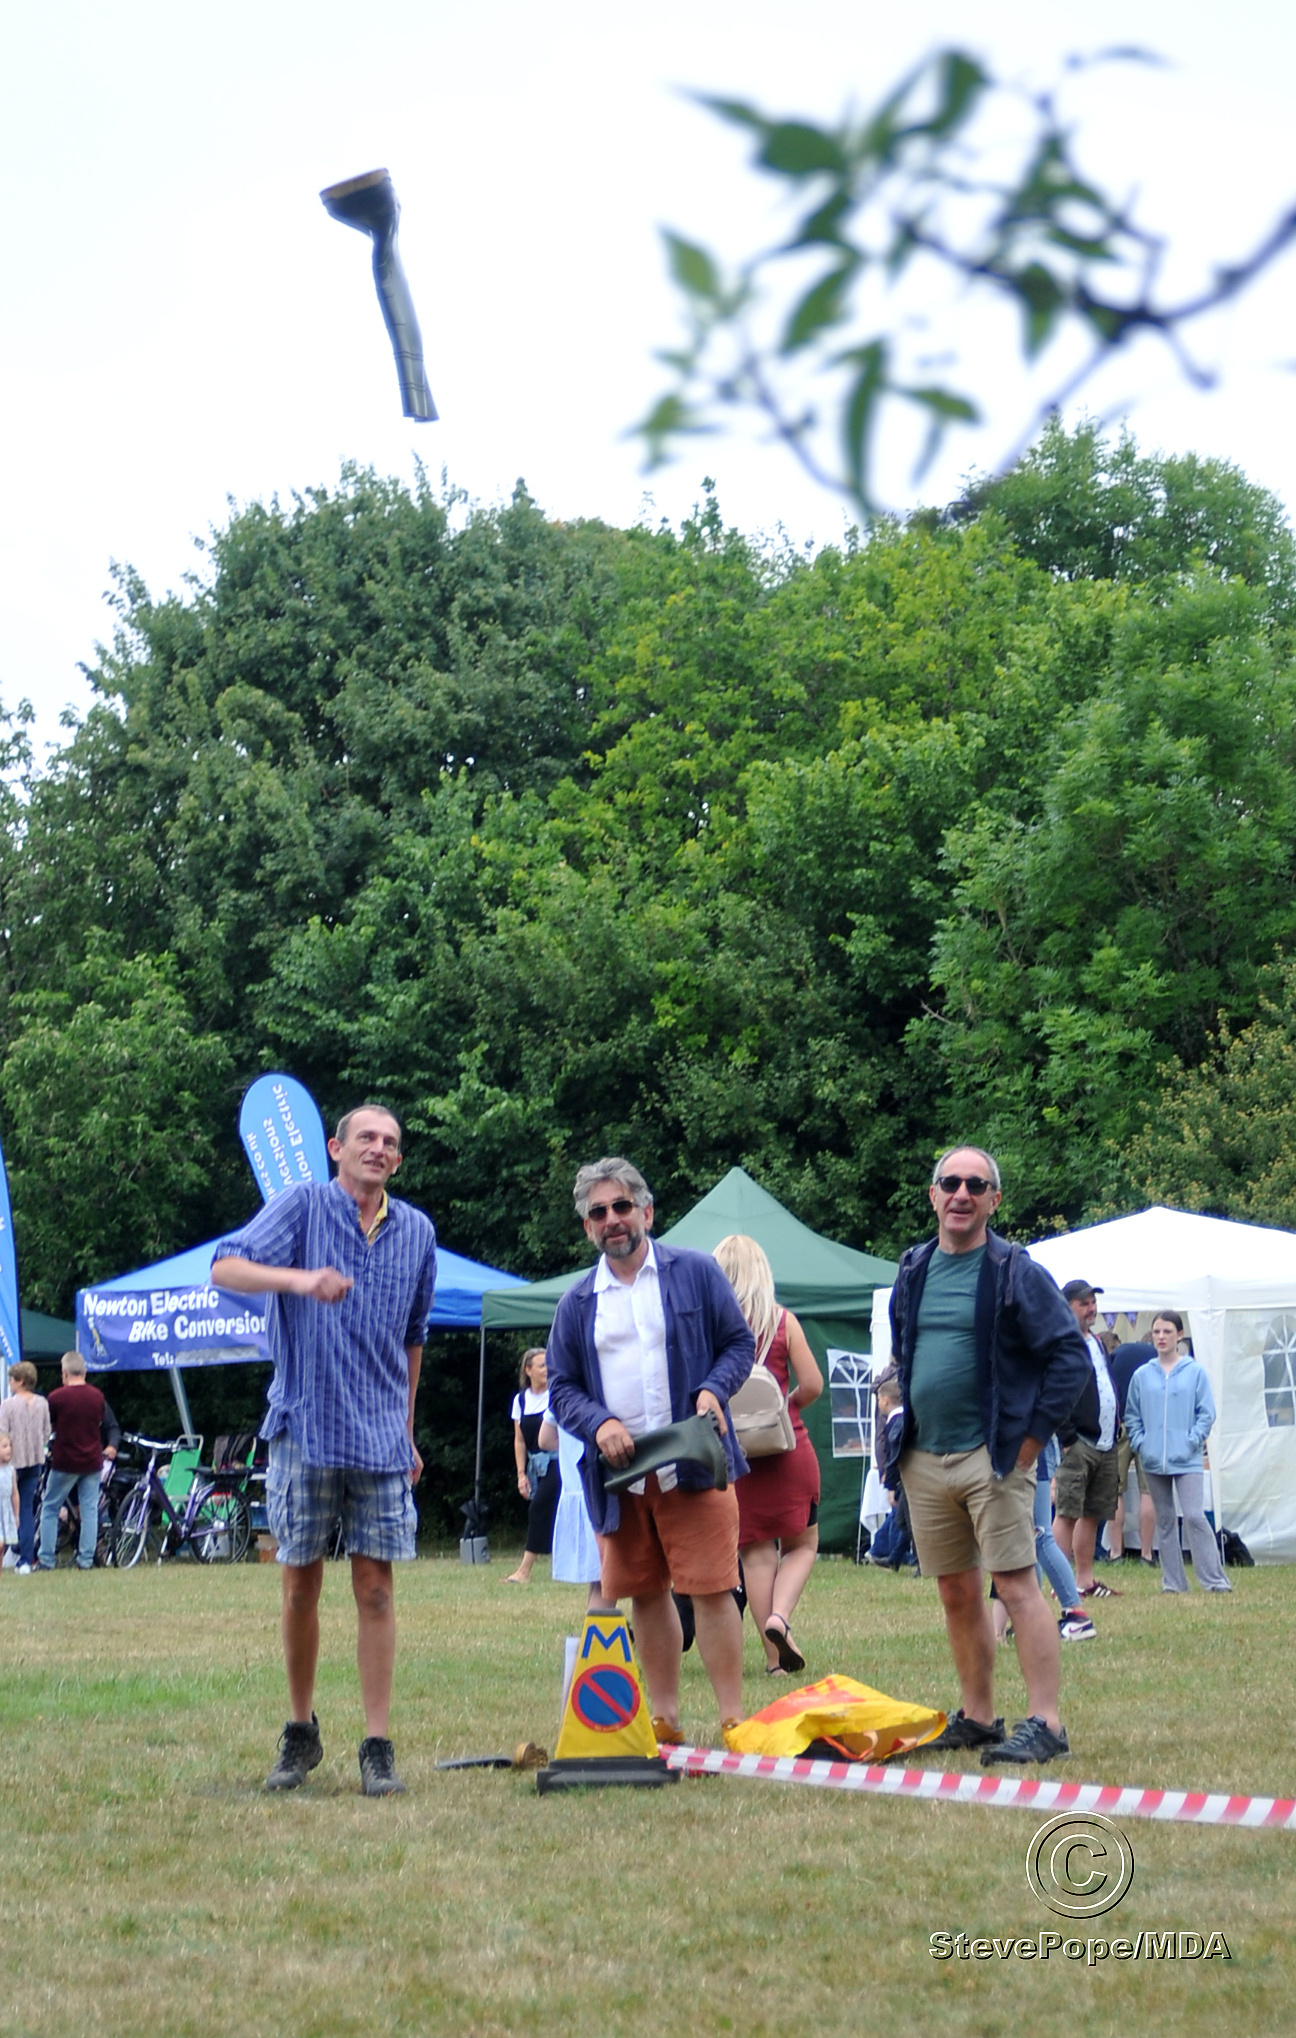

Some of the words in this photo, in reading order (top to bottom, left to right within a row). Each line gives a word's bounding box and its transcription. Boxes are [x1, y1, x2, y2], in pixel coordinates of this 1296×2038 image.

[83, 1292, 147, 1317] Newton
[150, 1285, 219, 1315] Electric
[128, 1319, 169, 1343] Bike
